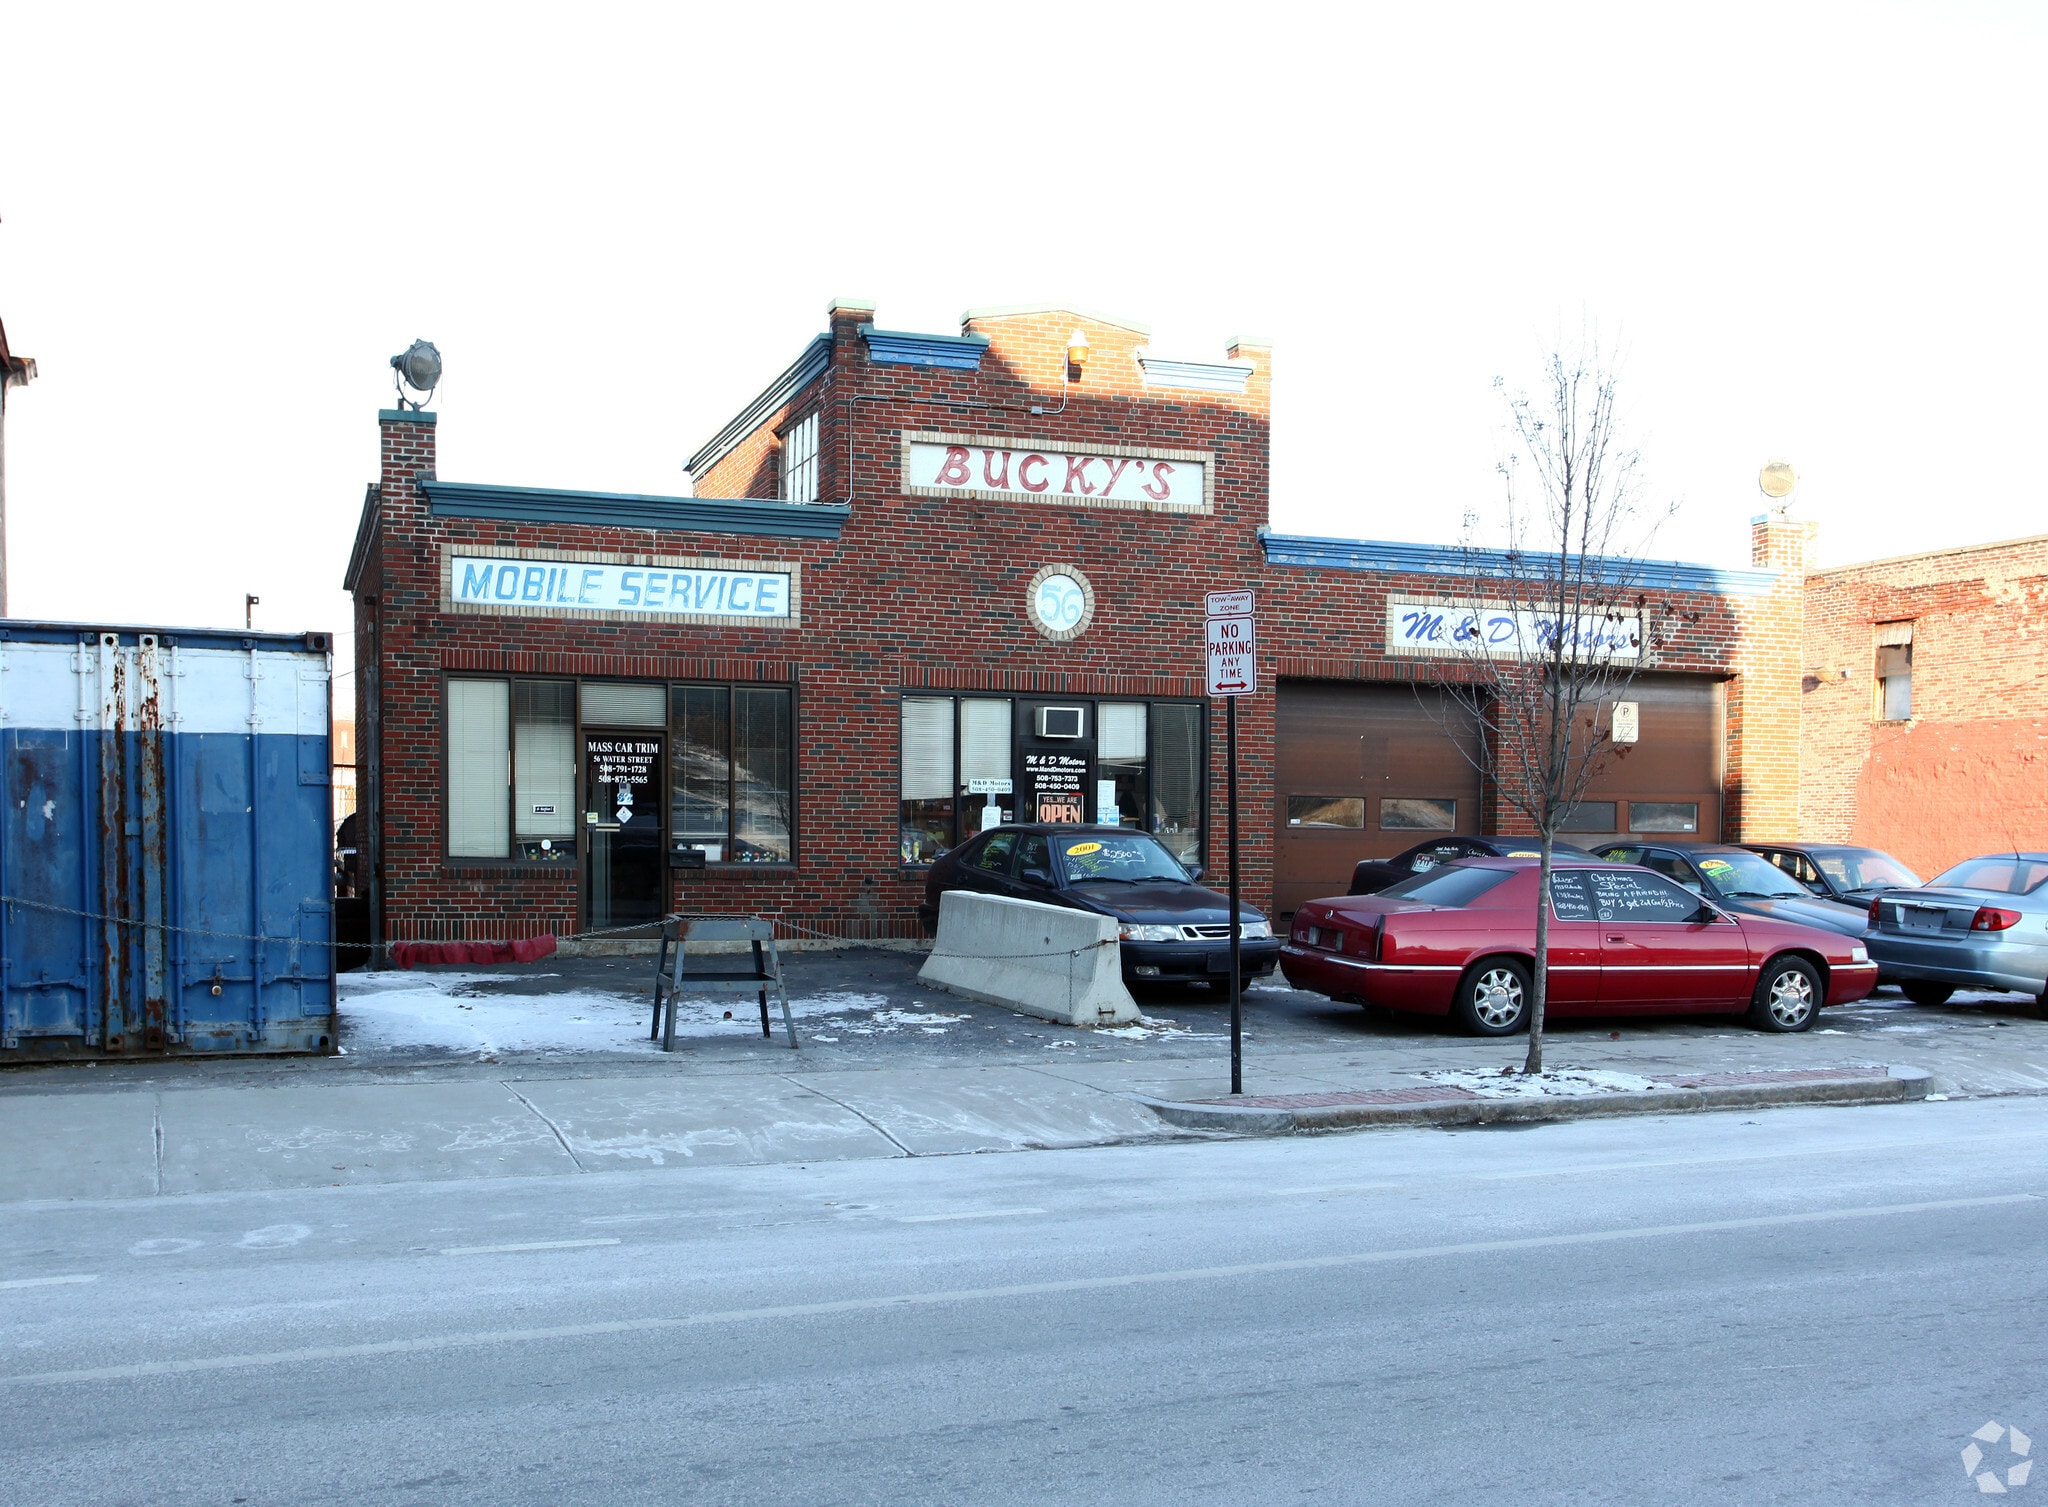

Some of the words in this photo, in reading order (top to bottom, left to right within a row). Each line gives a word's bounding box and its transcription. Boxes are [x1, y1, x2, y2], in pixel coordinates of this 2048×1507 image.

[934, 446, 1176, 500] BUCKY'S
[461, 563, 604, 603] MOBILE
[618, 571, 779, 613] SERVICE
[1040, 584, 1081, 624] 56
[1221, 624, 1239, 638] NO
[1402, 612, 1442, 642] M
[1453, 615, 1475, 642] &
[1487, 617, 1516, 643] D
[1209, 641, 1251, 656] PARKING
[1221, 657, 1240, 667] ANY
[1220, 668, 1242, 678] TIME
[587, 742, 613, 752] MASS
[615, 742, 633, 753] CAR
[635, 743, 659, 753] TRIM
[627, 756, 653, 764] STREET
[1026, 755, 1037, 765] M
[1039, 755, 1046, 765] &
[1048, 756, 1057, 765] D
[1059, 756, 1086, 766] Motors
[599, 765, 647, 774] 508-791-1728
[598, 775, 648, 784] 508-873-5565
[1040, 804, 1081, 823] OPEN
[1074, 843, 1095, 855] 2001
[1416, 860, 1433, 868] SALE
[1590, 873, 1633, 882] Christmas
[1599, 898, 1615, 907] BUY
[1618, 899, 1624, 908] 1
[1626, 898, 1640, 910] get
